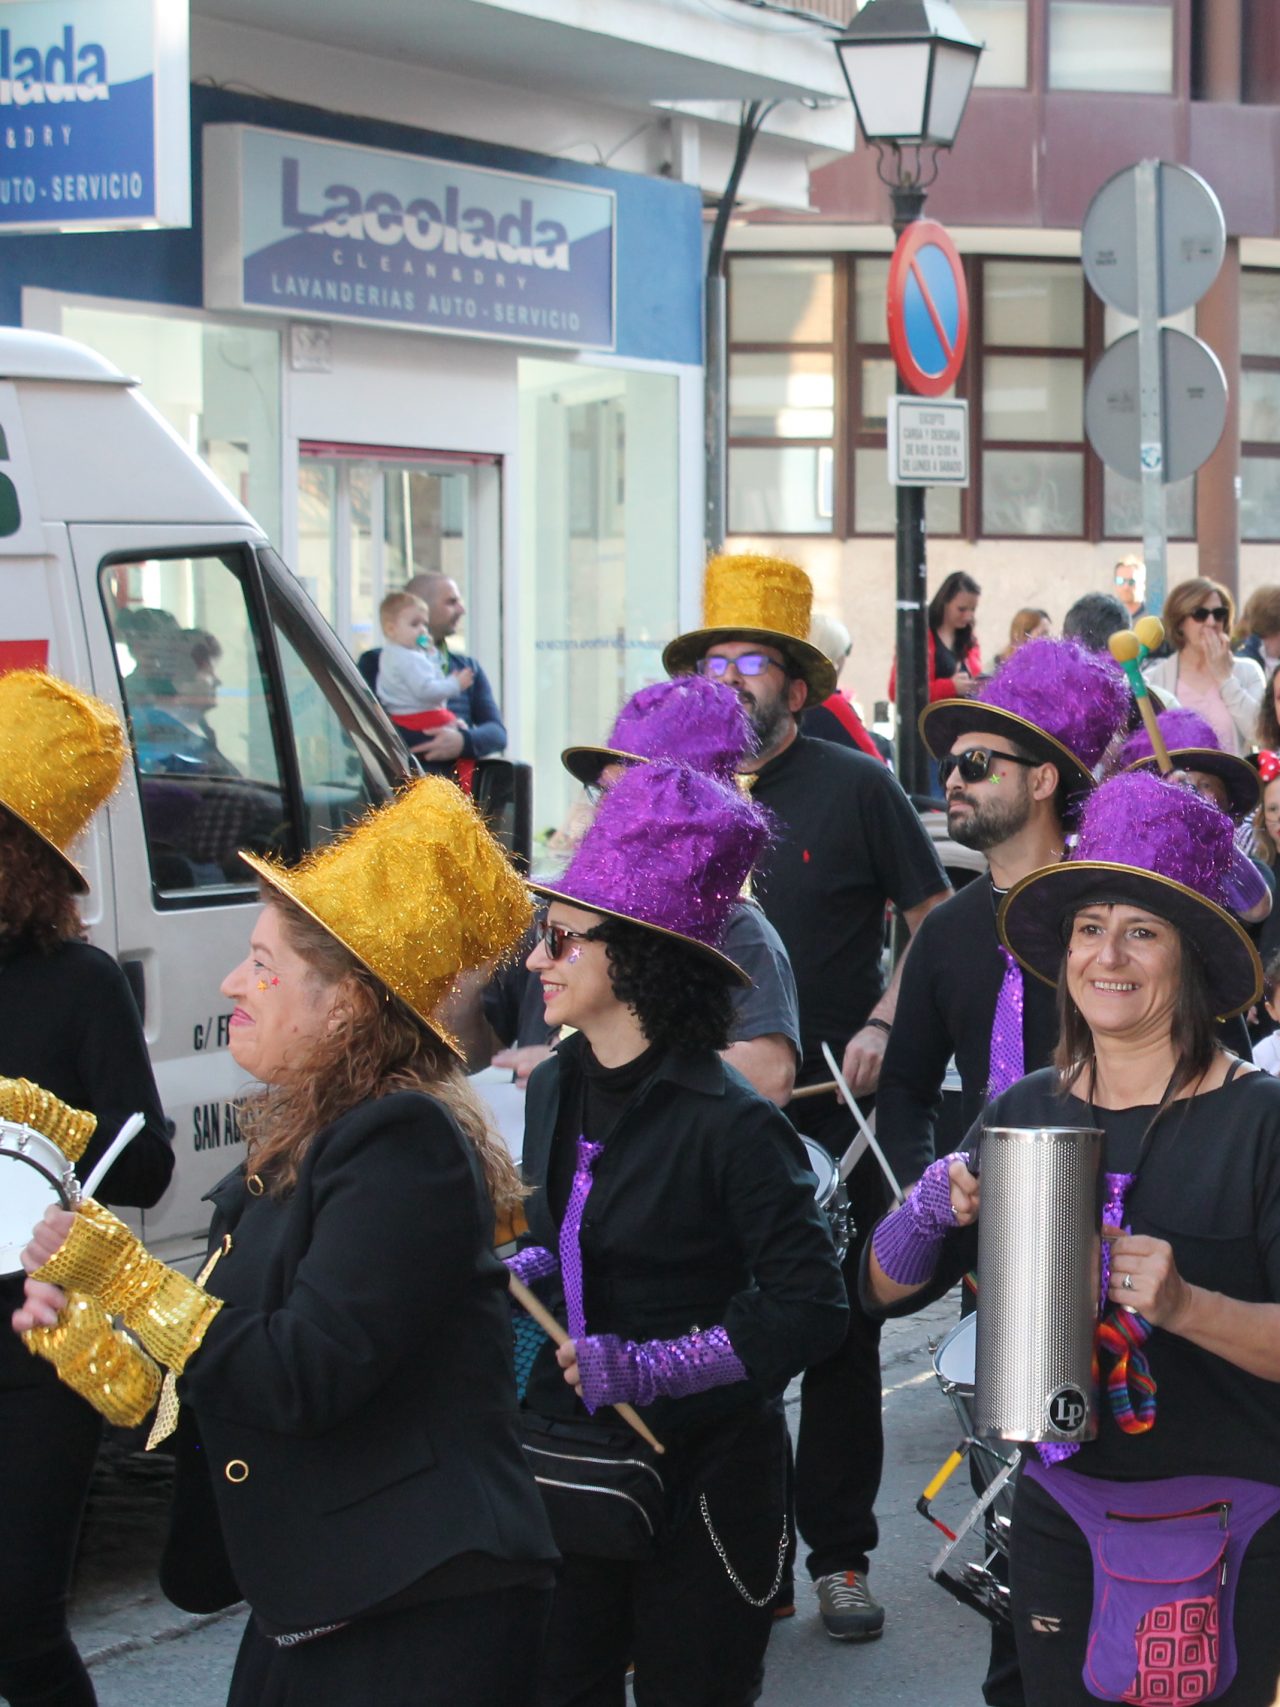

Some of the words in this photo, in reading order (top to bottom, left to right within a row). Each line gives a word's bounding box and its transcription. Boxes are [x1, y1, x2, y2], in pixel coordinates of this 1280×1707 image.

[282, 157, 570, 272] Lacolada
[271, 274, 415, 312] LAVANDERIAS
[193, 1102, 220, 1152] SAN
[1056, 1397, 1083, 1427] LP
